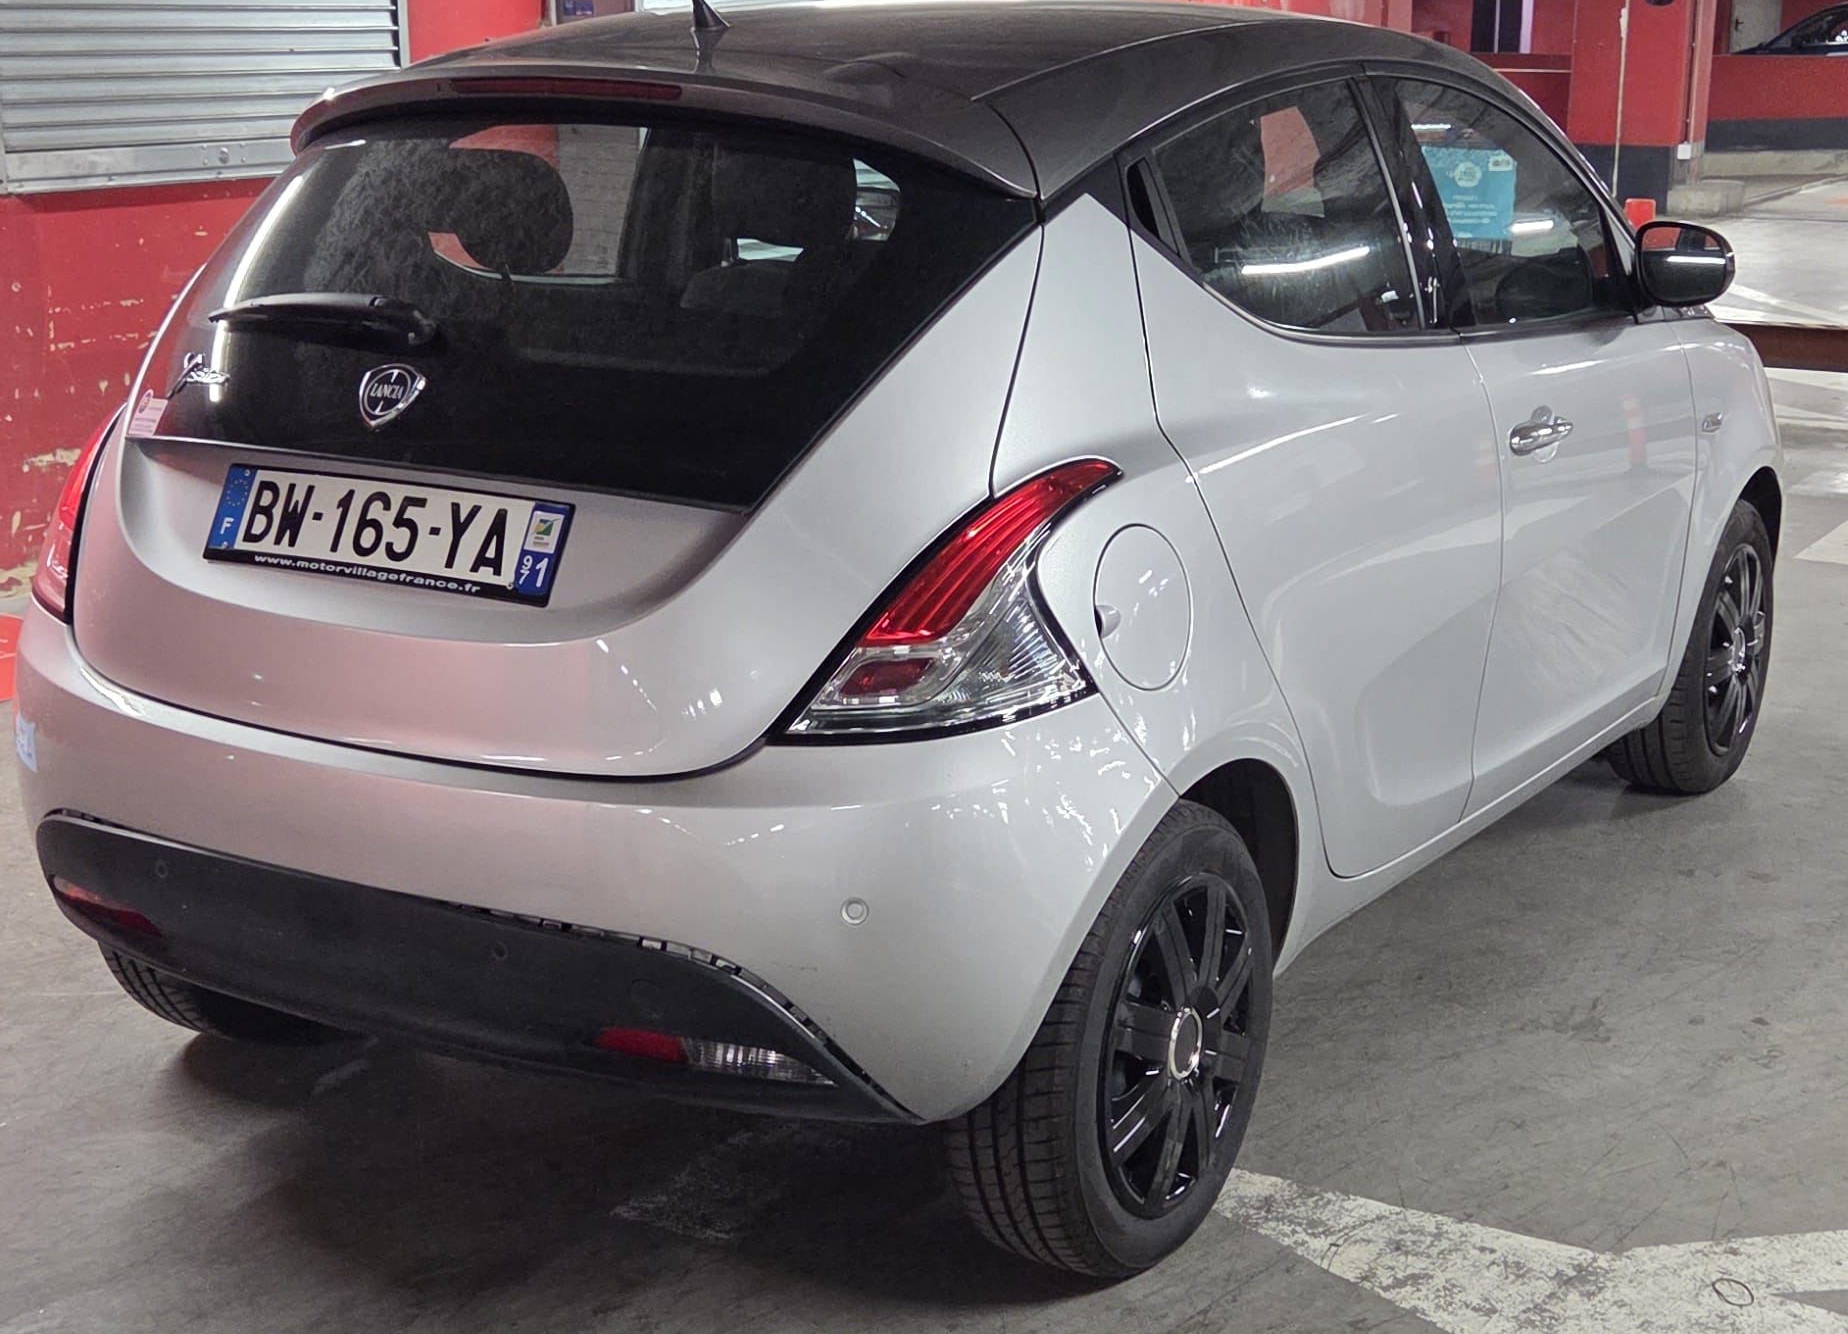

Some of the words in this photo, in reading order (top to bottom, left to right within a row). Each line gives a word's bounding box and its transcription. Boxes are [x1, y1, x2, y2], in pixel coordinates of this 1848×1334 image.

[370, 382, 404, 400] LANCIA
[220, 517, 234, 535] F
[242, 480, 508, 577] BW-165-YA
[254, 554, 481, 593] www.motorvillagefrance.fr
